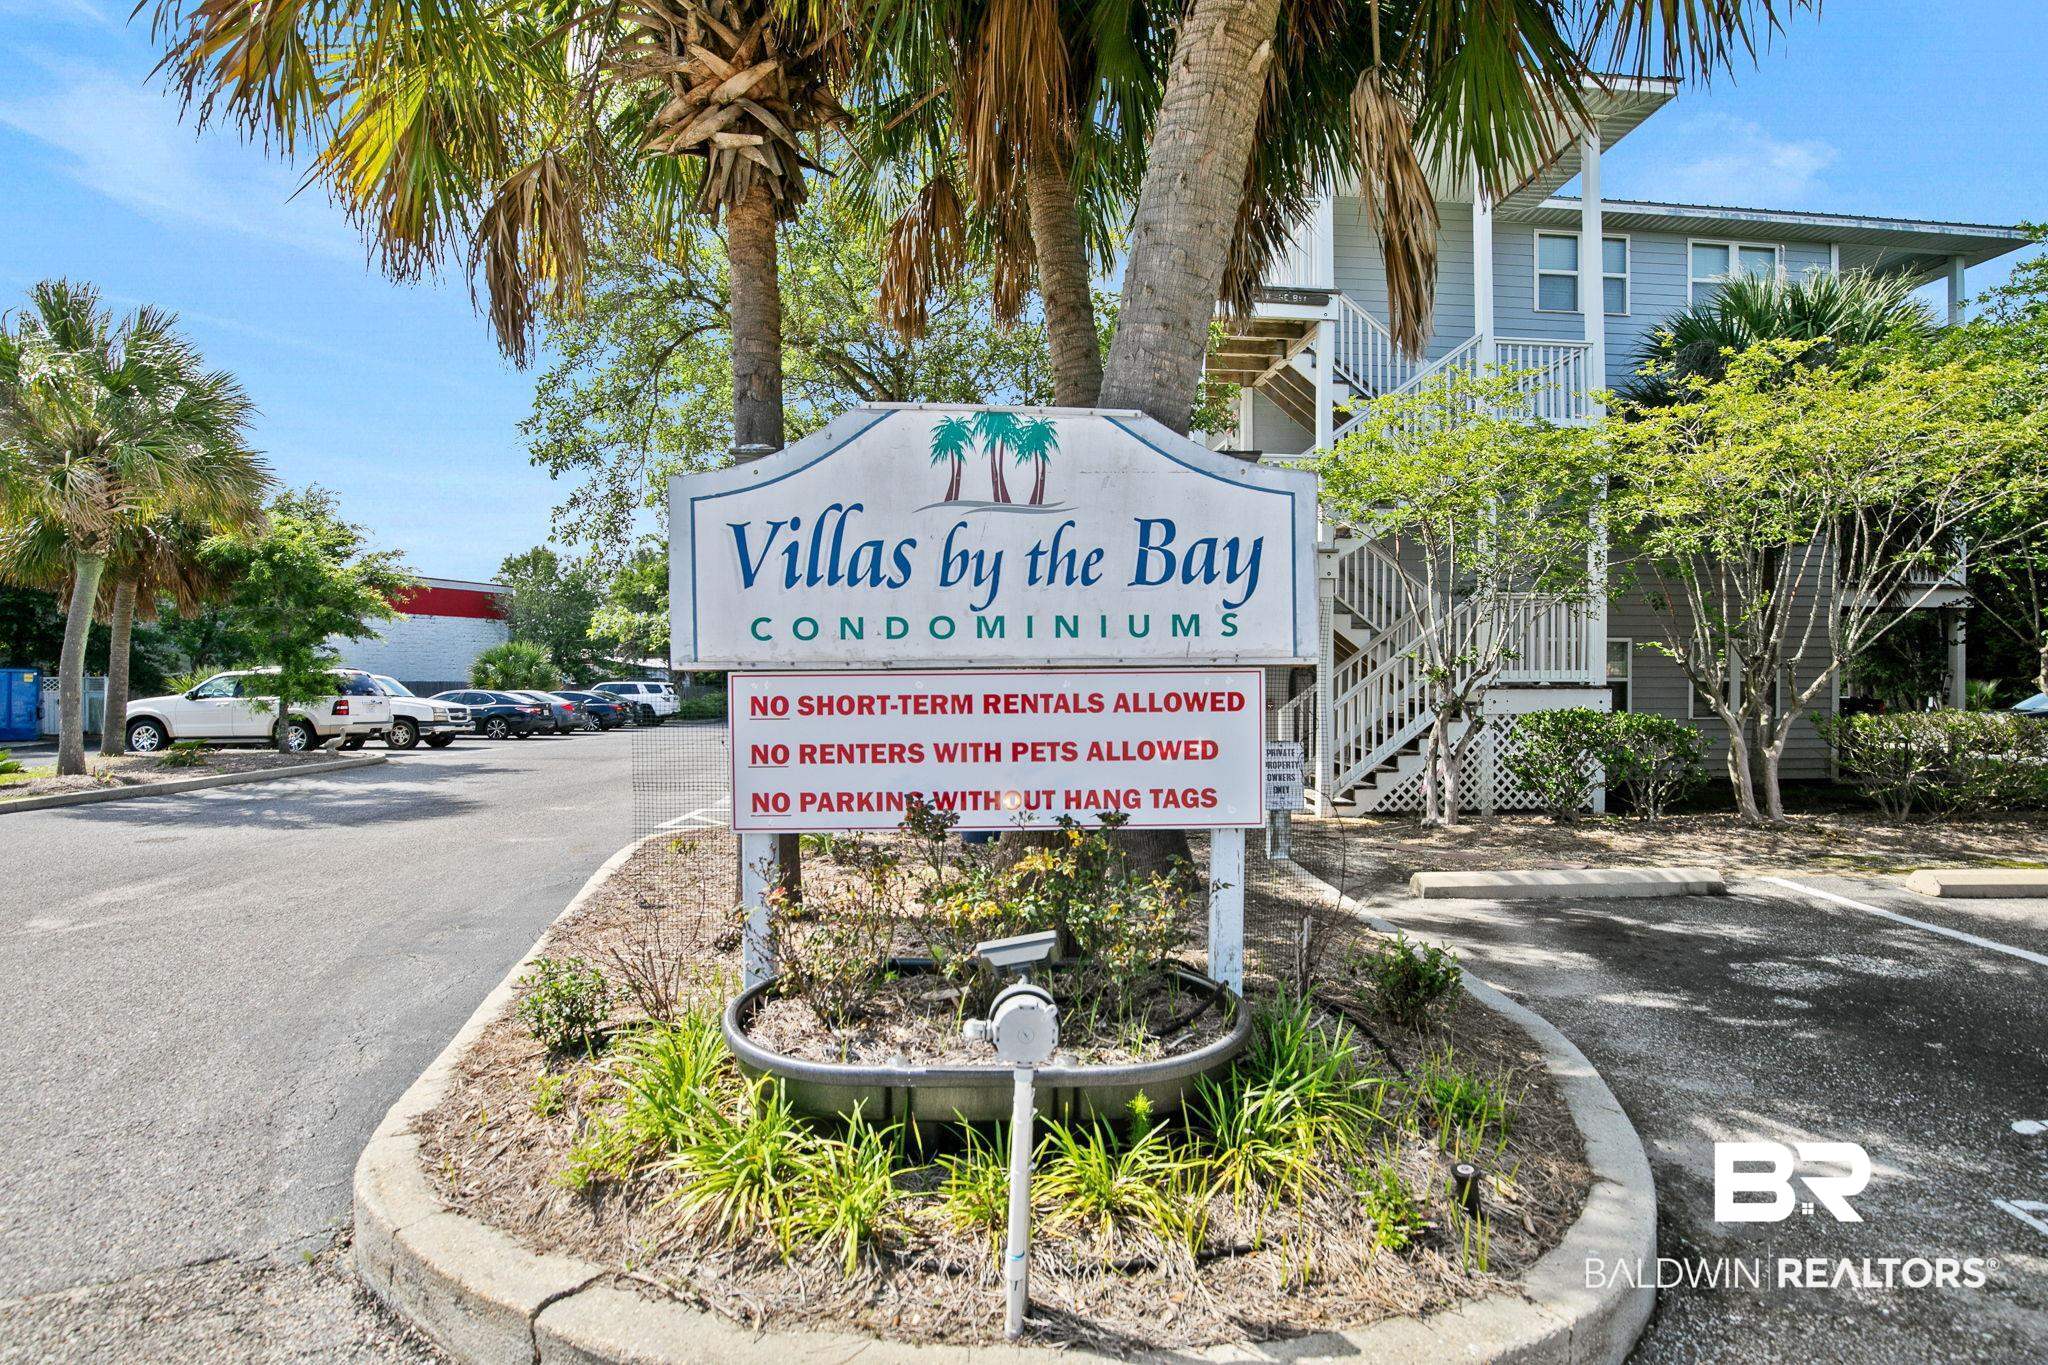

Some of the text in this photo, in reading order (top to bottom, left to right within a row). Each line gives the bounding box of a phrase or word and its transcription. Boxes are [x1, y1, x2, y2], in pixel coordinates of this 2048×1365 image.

[727, 503, 1264, 612] Villas by the Bay
[750, 612, 1238, 642] CONDOMINIUMS
[750, 691, 1245, 716] NO SHORT-TERM RENTALS ALLOWED
[751, 739, 1219, 765] NO RENTERS WITH PETS ALLOWED
[1266, 748, 1295, 757] PRIVATE
[751, 792, 790, 813] NO
[933, 790, 1055, 812] WITHOUT
[1064, 788, 1141, 811] HANG
[1149, 788, 1218, 809] TAGS
